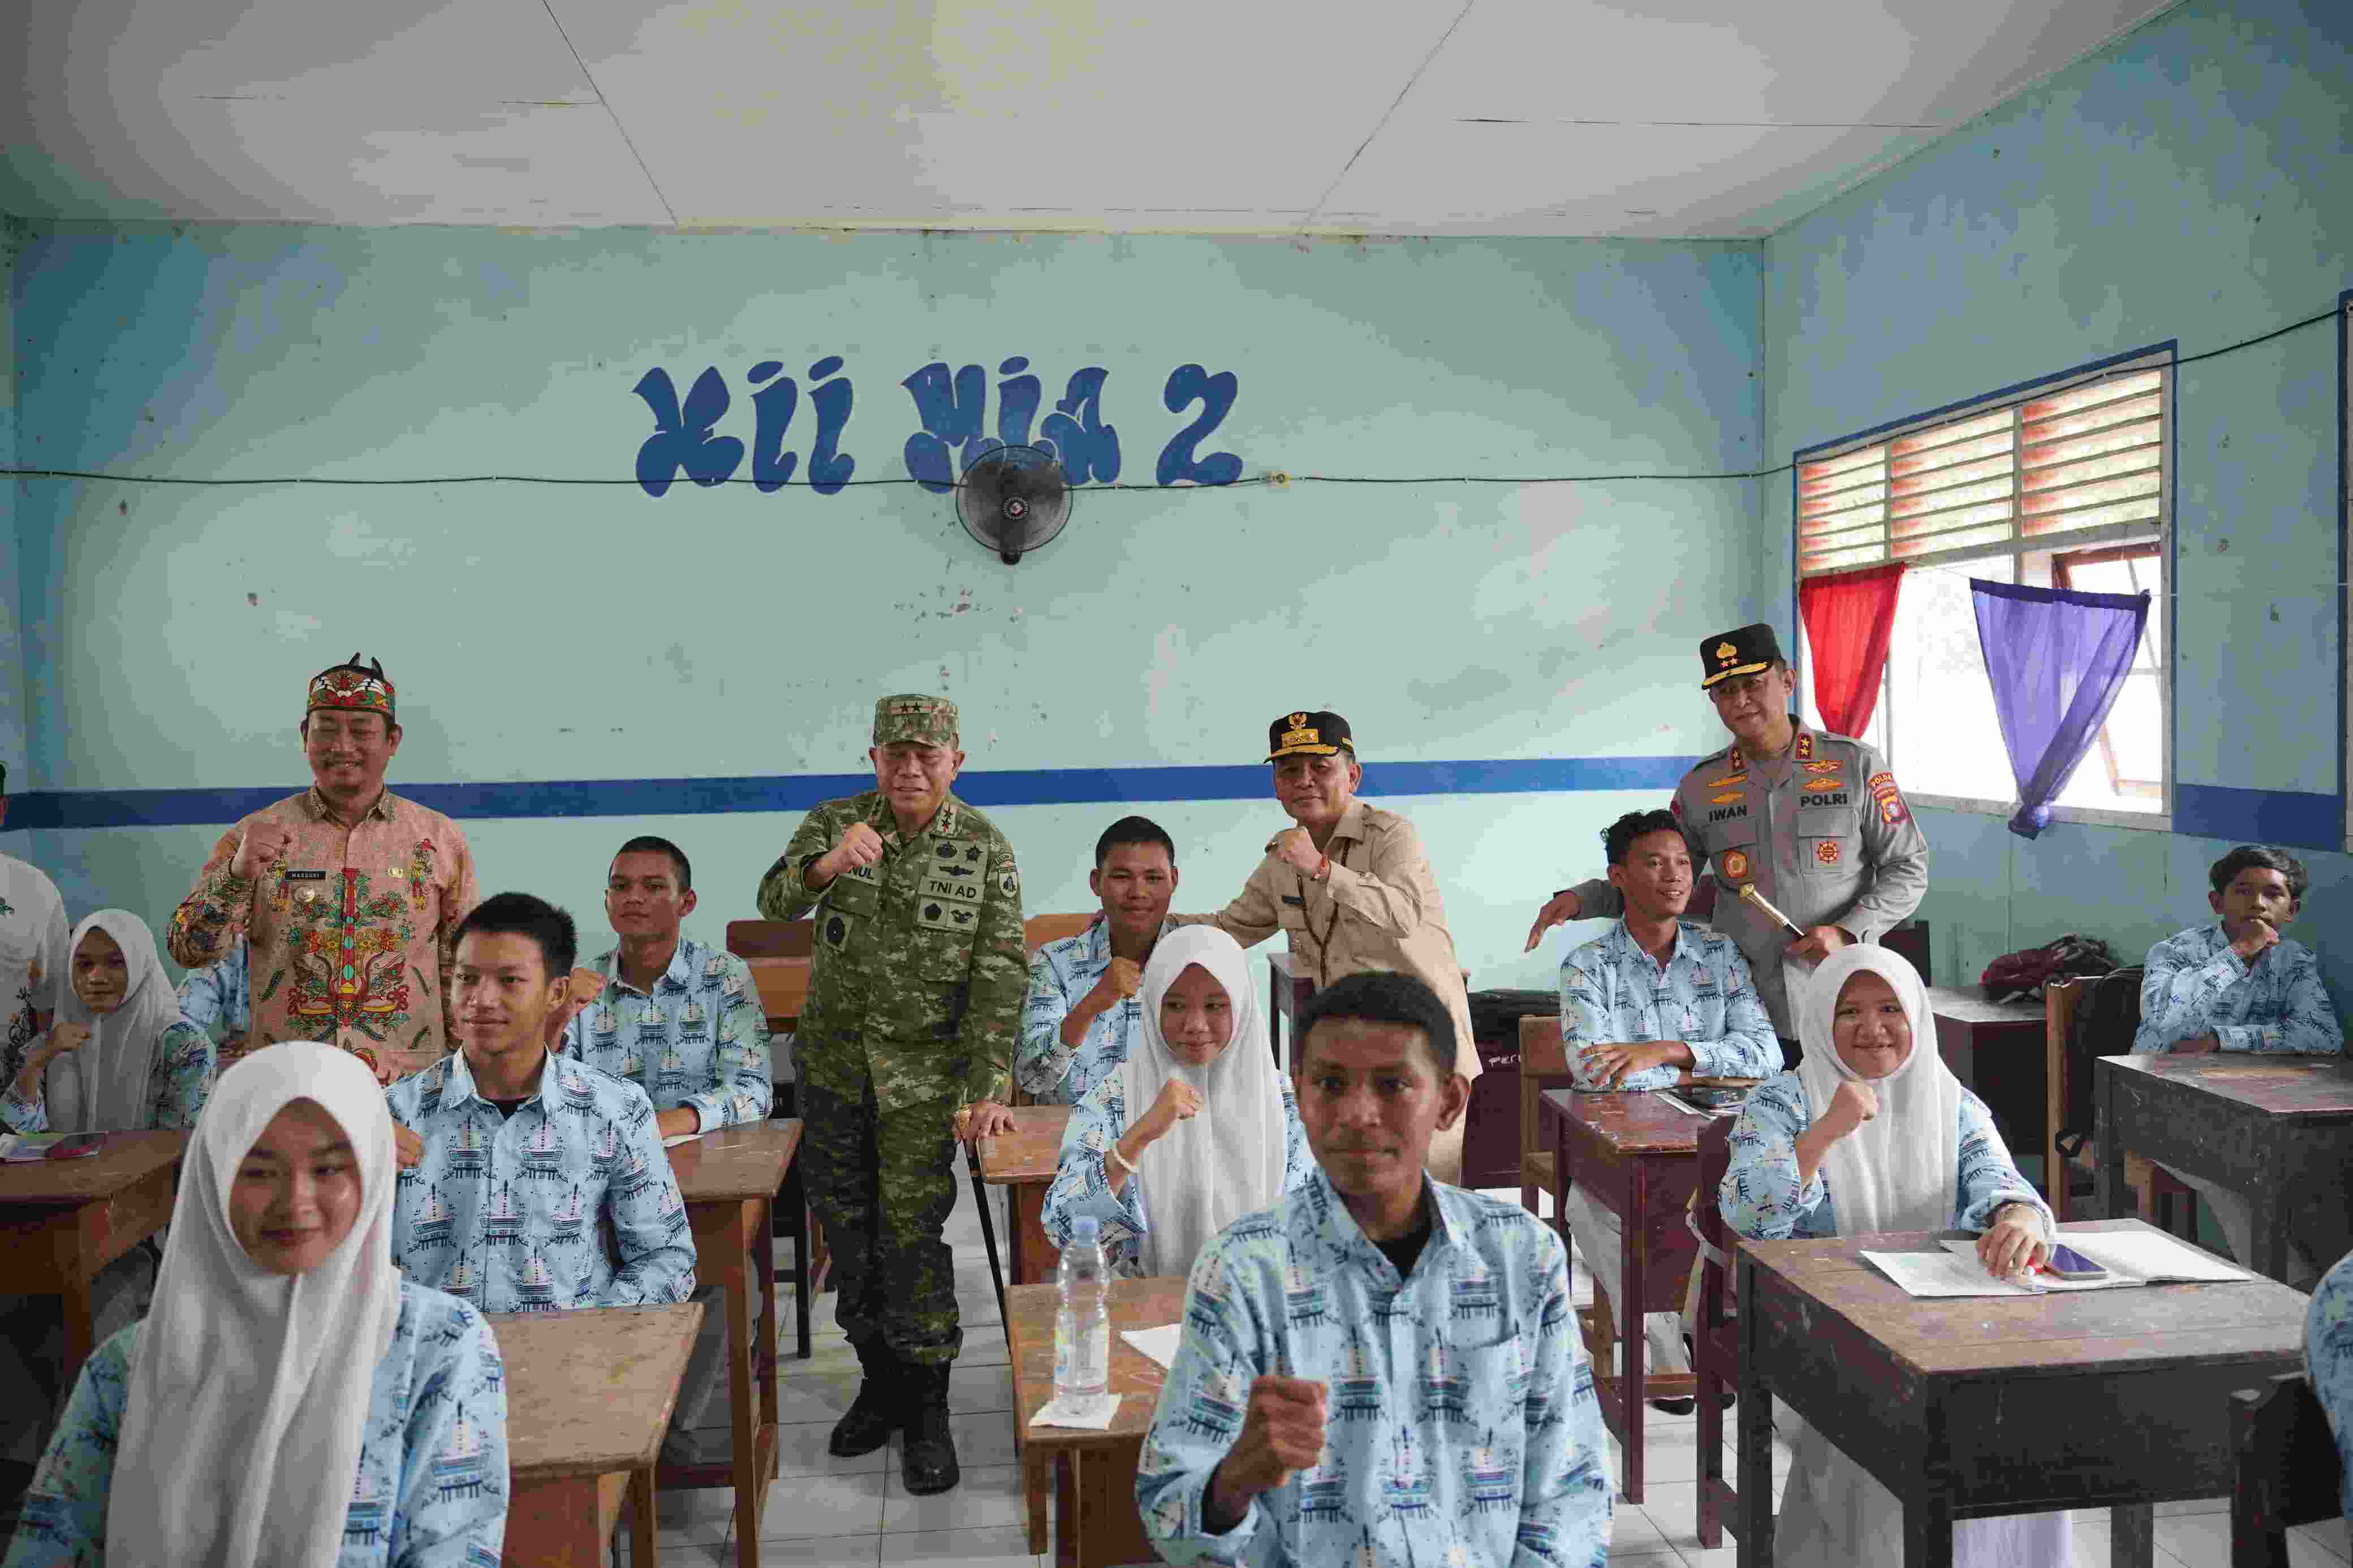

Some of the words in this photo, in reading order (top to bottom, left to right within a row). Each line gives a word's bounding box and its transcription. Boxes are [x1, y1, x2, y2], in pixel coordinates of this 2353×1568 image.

[1156, 363, 1243, 487] 2
[1800, 793, 1848, 807] POLRI
[1708, 805, 1747, 822] IWAN
[929, 880, 951, 893] TNI
[955, 885, 976, 898] AD
